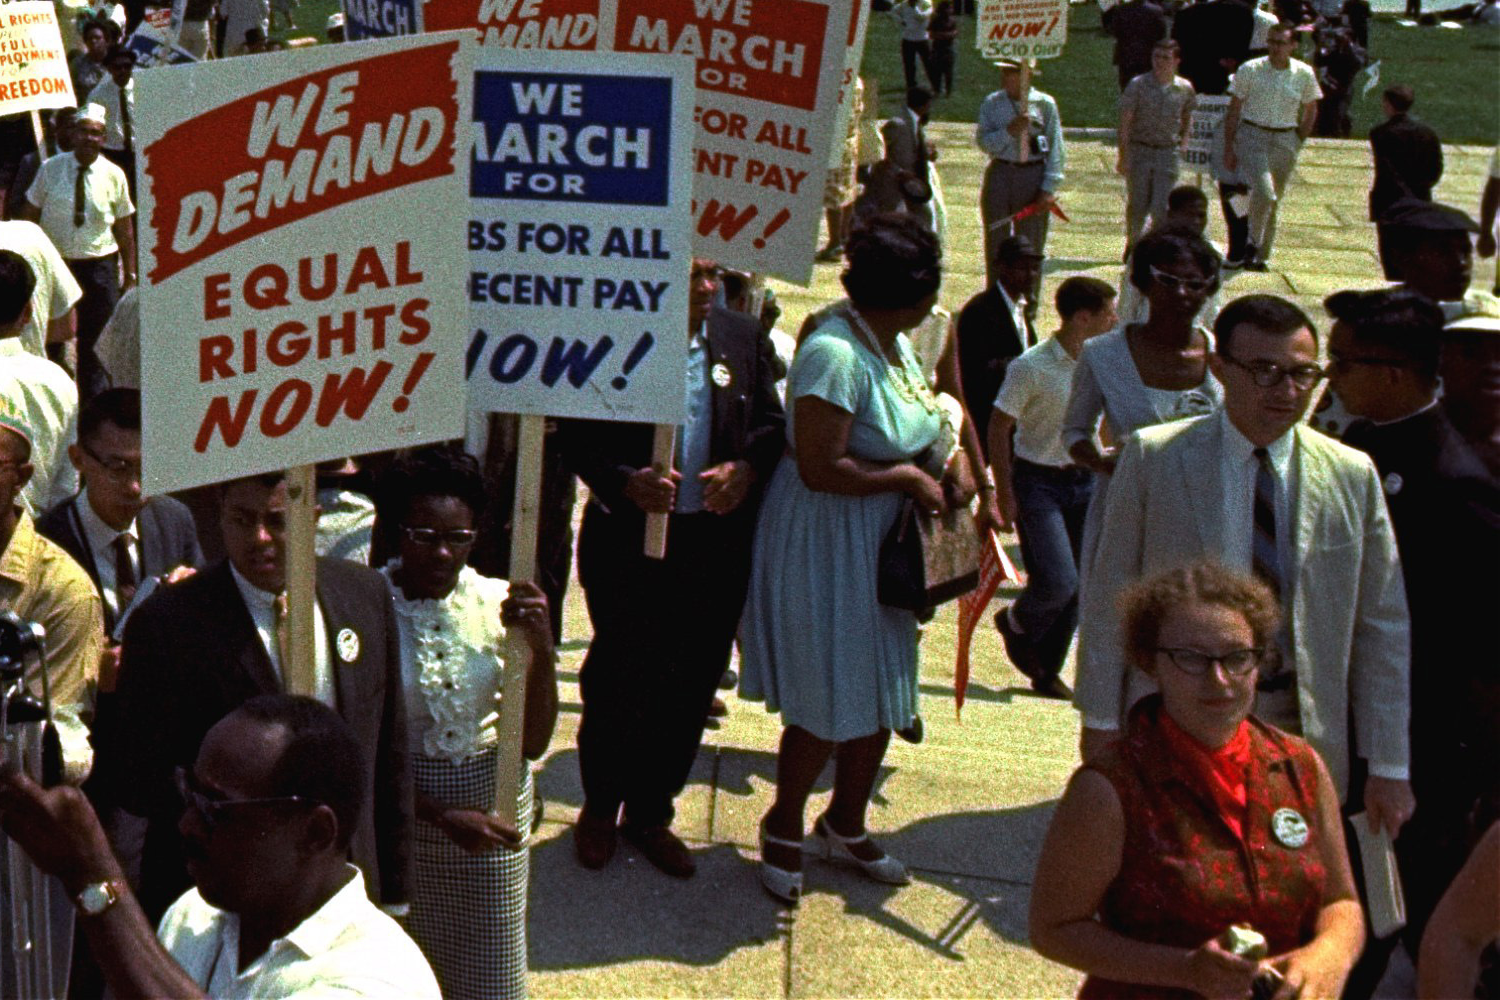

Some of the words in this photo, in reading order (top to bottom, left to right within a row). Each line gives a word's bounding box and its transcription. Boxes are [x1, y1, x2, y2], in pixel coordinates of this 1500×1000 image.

[9, 13, 53, 27] RIGHTS
[484, 13, 598, 49] MAND
[989, 16, 1060, 40] NOW!
[1, 38, 36, 53] FULL
[629, 15, 806, 78] MARCH
[700, 67, 748, 90] OR
[247, 70, 360, 158] WE
[511, 82, 583, 117] WE
[754, 120, 813, 155] ALL
[171, 106, 445, 254] DEMAND
[504, 172, 585, 195] FOR
[745, 158, 809, 195] PAY
[467, 220, 507, 252] BS
[518, 222, 591, 256] FOR
[600, 227, 670, 260] ALL
[692, 198, 792, 249] W!
[204, 241, 423, 321] EQUAL
[467, 272, 584, 308] ECENT
[594, 278, 670, 313] PAY
[199, 298, 431, 383] RIGHTS
[193, 352, 436, 454] NOW!
